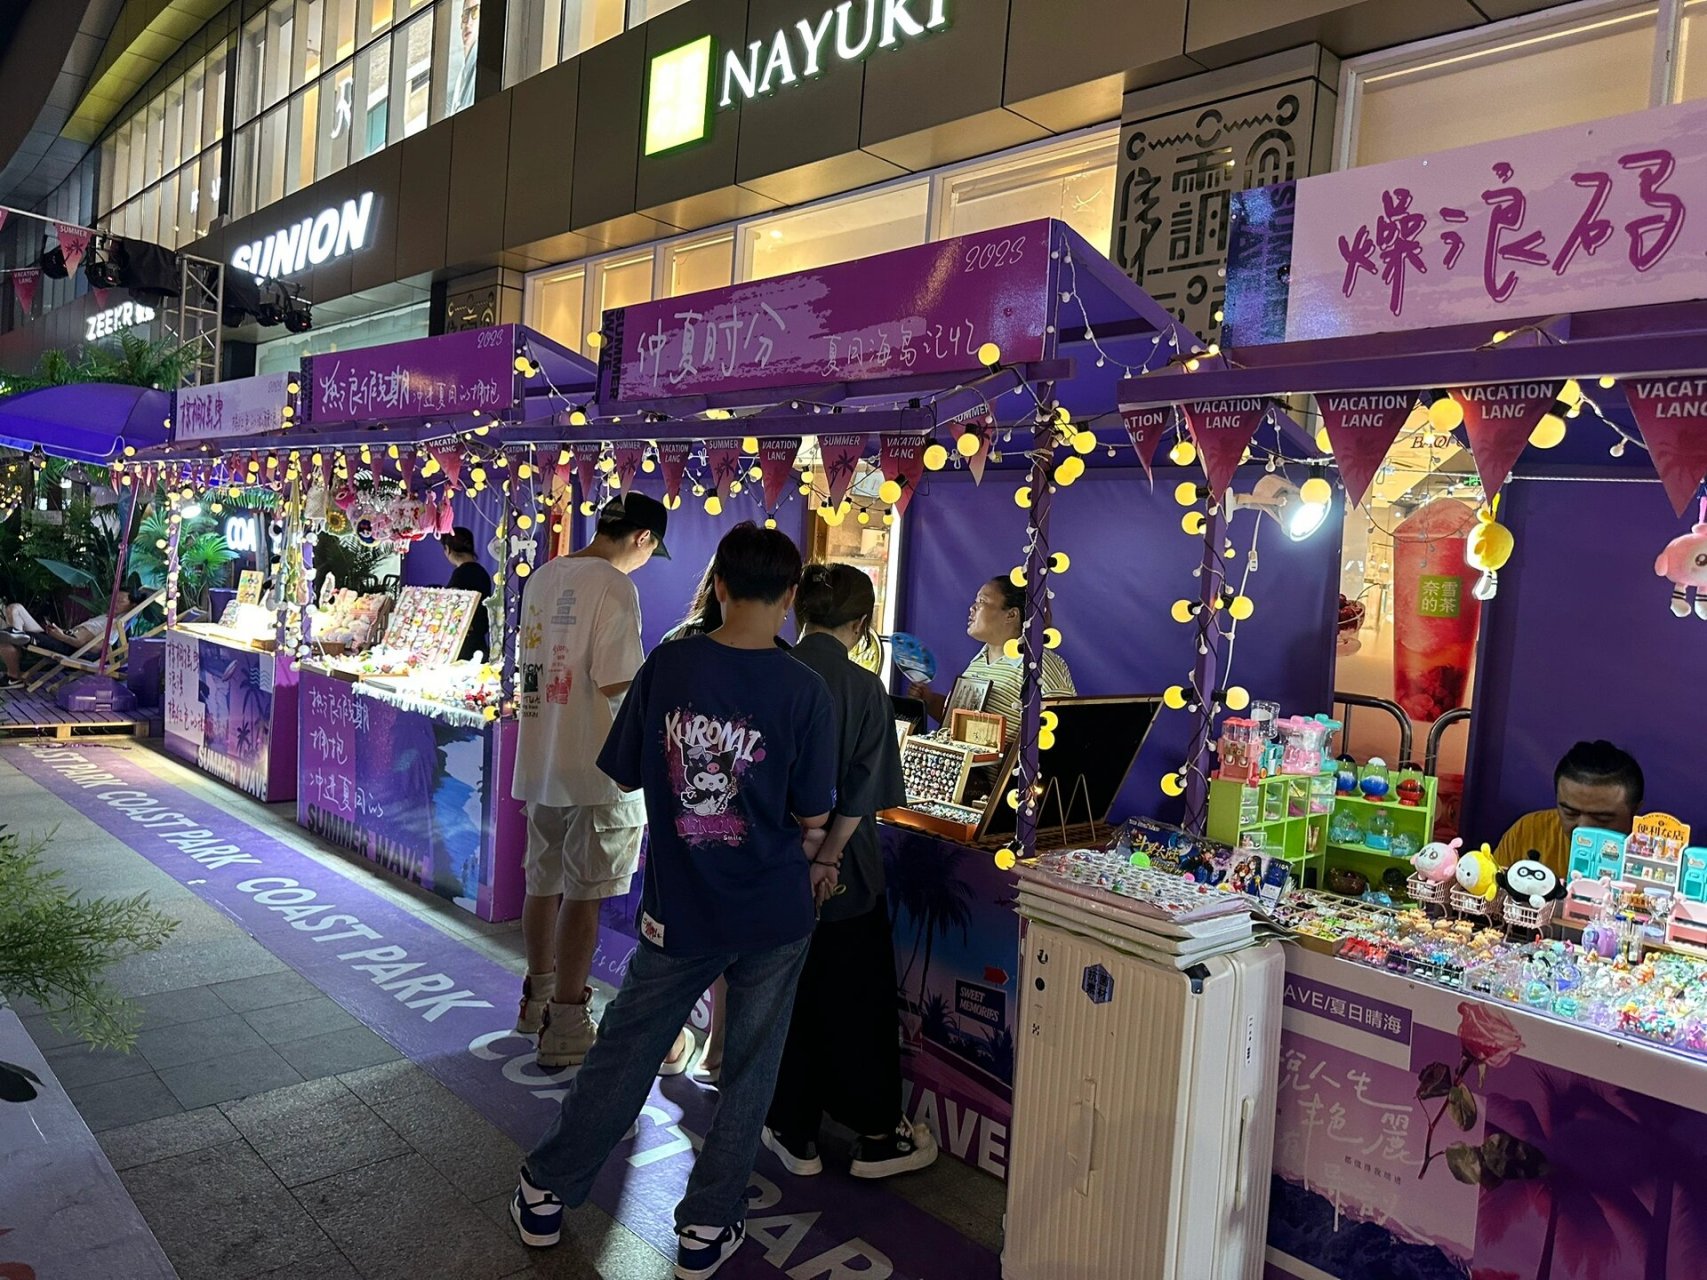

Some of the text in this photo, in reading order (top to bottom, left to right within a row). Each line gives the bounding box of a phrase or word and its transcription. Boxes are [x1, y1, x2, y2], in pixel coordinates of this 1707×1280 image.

[60, 225, 88, 238] SUMMER
[231, 191, 374, 286] SUNION
[964, 236, 1026, 273] 2023
[14, 270, 40, 279] VACATION
[85, 301, 134, 341] ZEEKR
[637, 302, 786, 388] 仲夏时分
[609, 308, 626, 400] SUMMER
[1461, 383, 1553, 401] VACATION
[1193, 398, 1261, 414] VACATION
[1328, 394, 1408, 412] VACATION
[1481, 403, 1526, 420] LANG
[1205, 415, 1241, 429] LANG
[1341, 413, 1384, 428] LANG
[537, 443, 558, 451] SUMMER
[616, 441, 642, 449] SUMMER
[709, 439, 739, 450] SUMMER
[761, 440, 798, 450] VACATION
[823, 435, 860, 446] SUMMER
[437, 445, 457, 454] LANG
[660, 444, 689, 453] VACATION
[767, 451, 786, 461] LANG
[889, 448, 914, 459] LANG
[579, 454, 592, 462] LANG
[664, 455, 681, 463] LANG
[1423, 580, 1459, 598] 奈雪
[1421, 598, 1456, 613] 的茶
[665, 711, 762, 763] KUROMI
[197, 744, 268, 802] SUMMER WAVE
[306, 802, 376, 863] SUMMER
[52, 763, 129, 789] PARK
[96, 790, 200, 829] COAST
[157, 829, 263, 871] PARK
[236, 876, 384, 943] COAST
[336, 944, 496, 1023] PARK
[959, 986, 986, 1004] SWEET
[959, 998, 1000, 1023] MEMORIES
